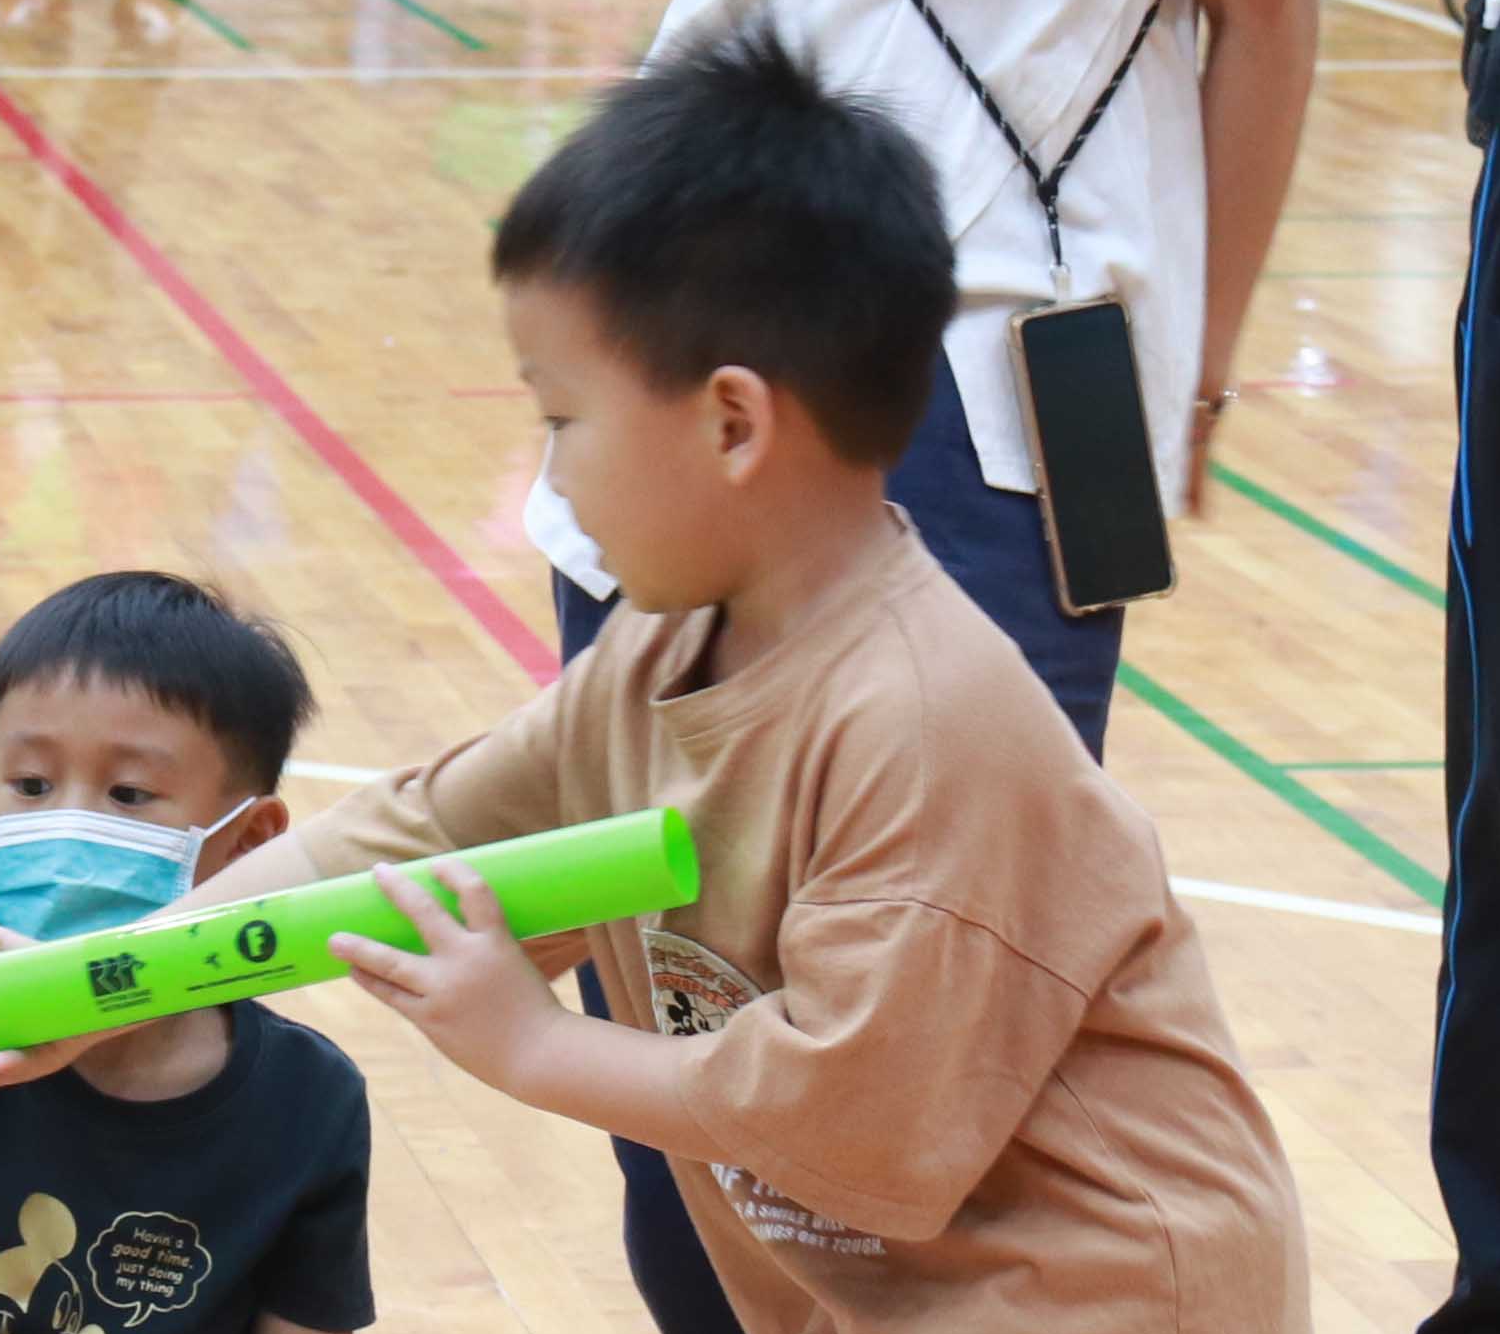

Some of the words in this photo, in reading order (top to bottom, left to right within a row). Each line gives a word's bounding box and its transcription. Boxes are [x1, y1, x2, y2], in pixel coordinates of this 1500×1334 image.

[110, 1243, 153, 1260] good
[114, 1262, 145, 1274] just
[147, 1266, 185, 1285] doing
[115, 1276, 136, 1291] my
